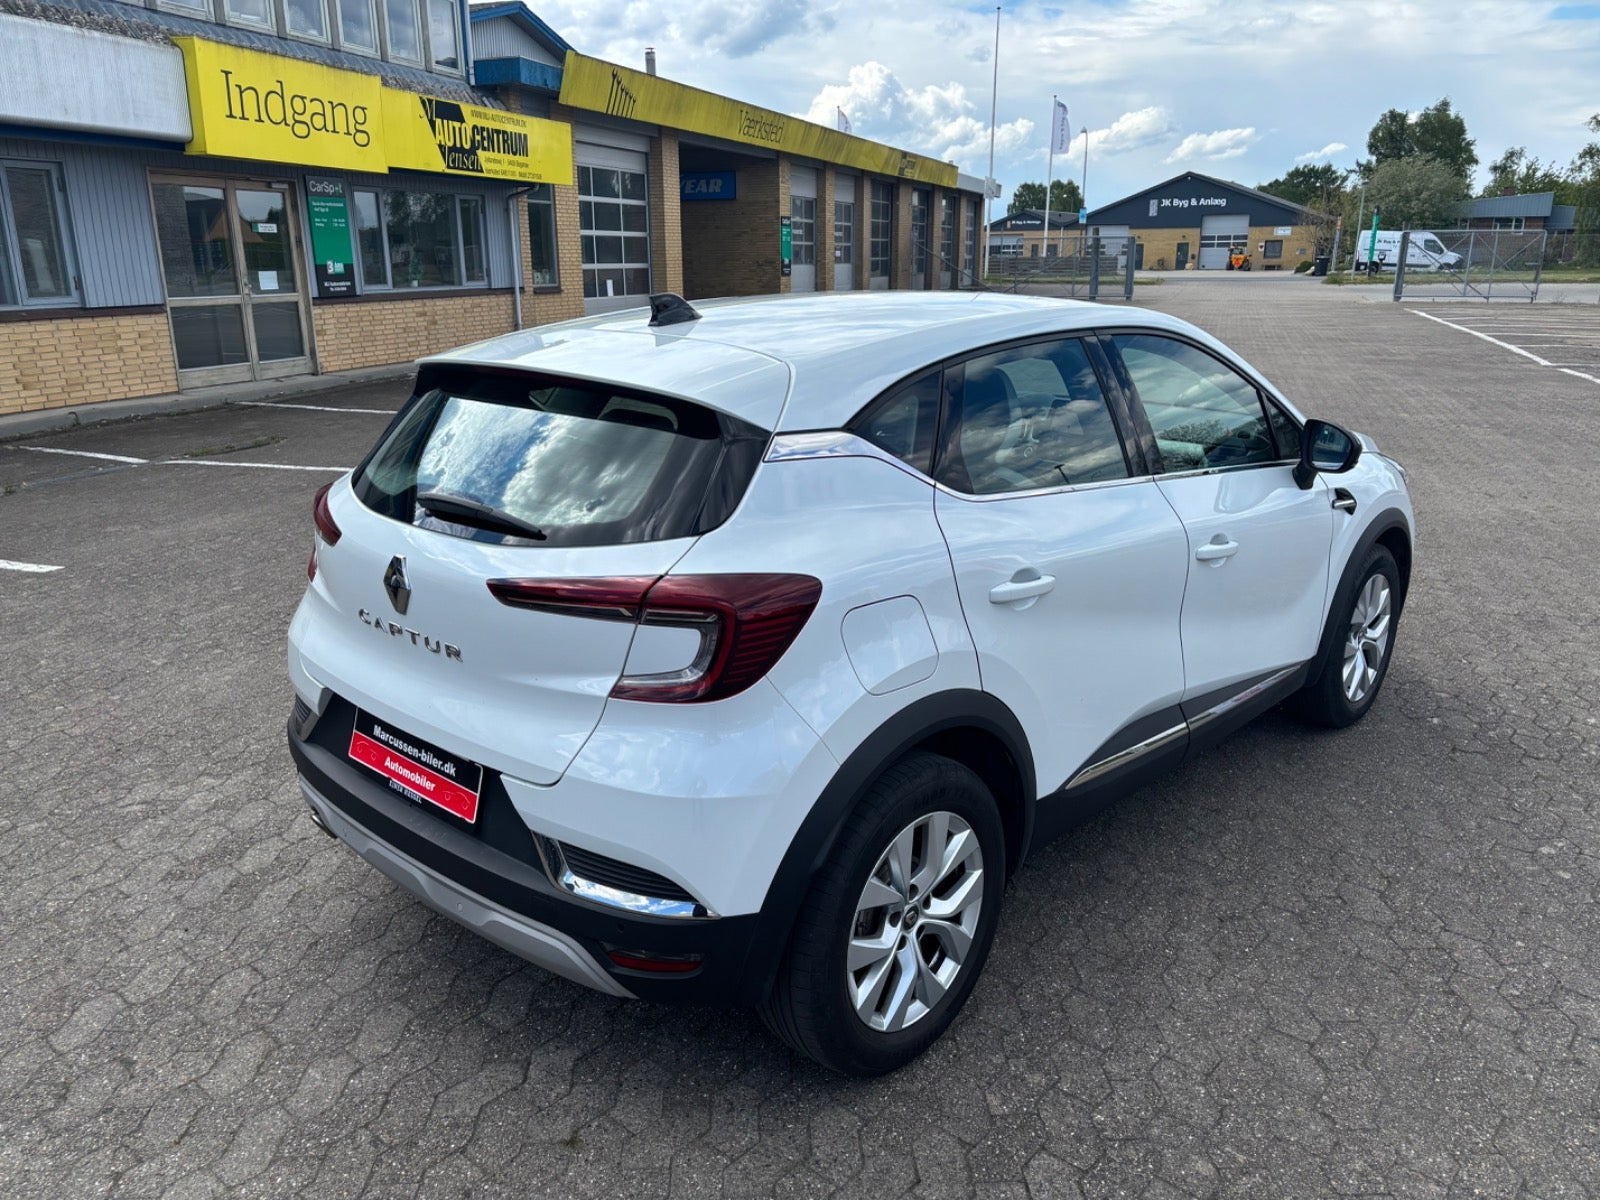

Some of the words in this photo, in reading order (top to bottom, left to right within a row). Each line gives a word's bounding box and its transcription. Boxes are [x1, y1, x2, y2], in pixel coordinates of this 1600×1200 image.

[221, 69, 370, 148] Indgang
[738, 109, 784, 144] Værksted
[1160, 198, 1171, 207] JK
[1173, 198, 1189, 208] Byg
[1190, 197, 1197, 206] &
[1199, 196, 1227, 207] Anlæg
[358, 608, 463, 662] CAPTUR
[373, 724, 457, 777] Marcussen-biler.dk
[383, 756, 437, 792] Automobiler
